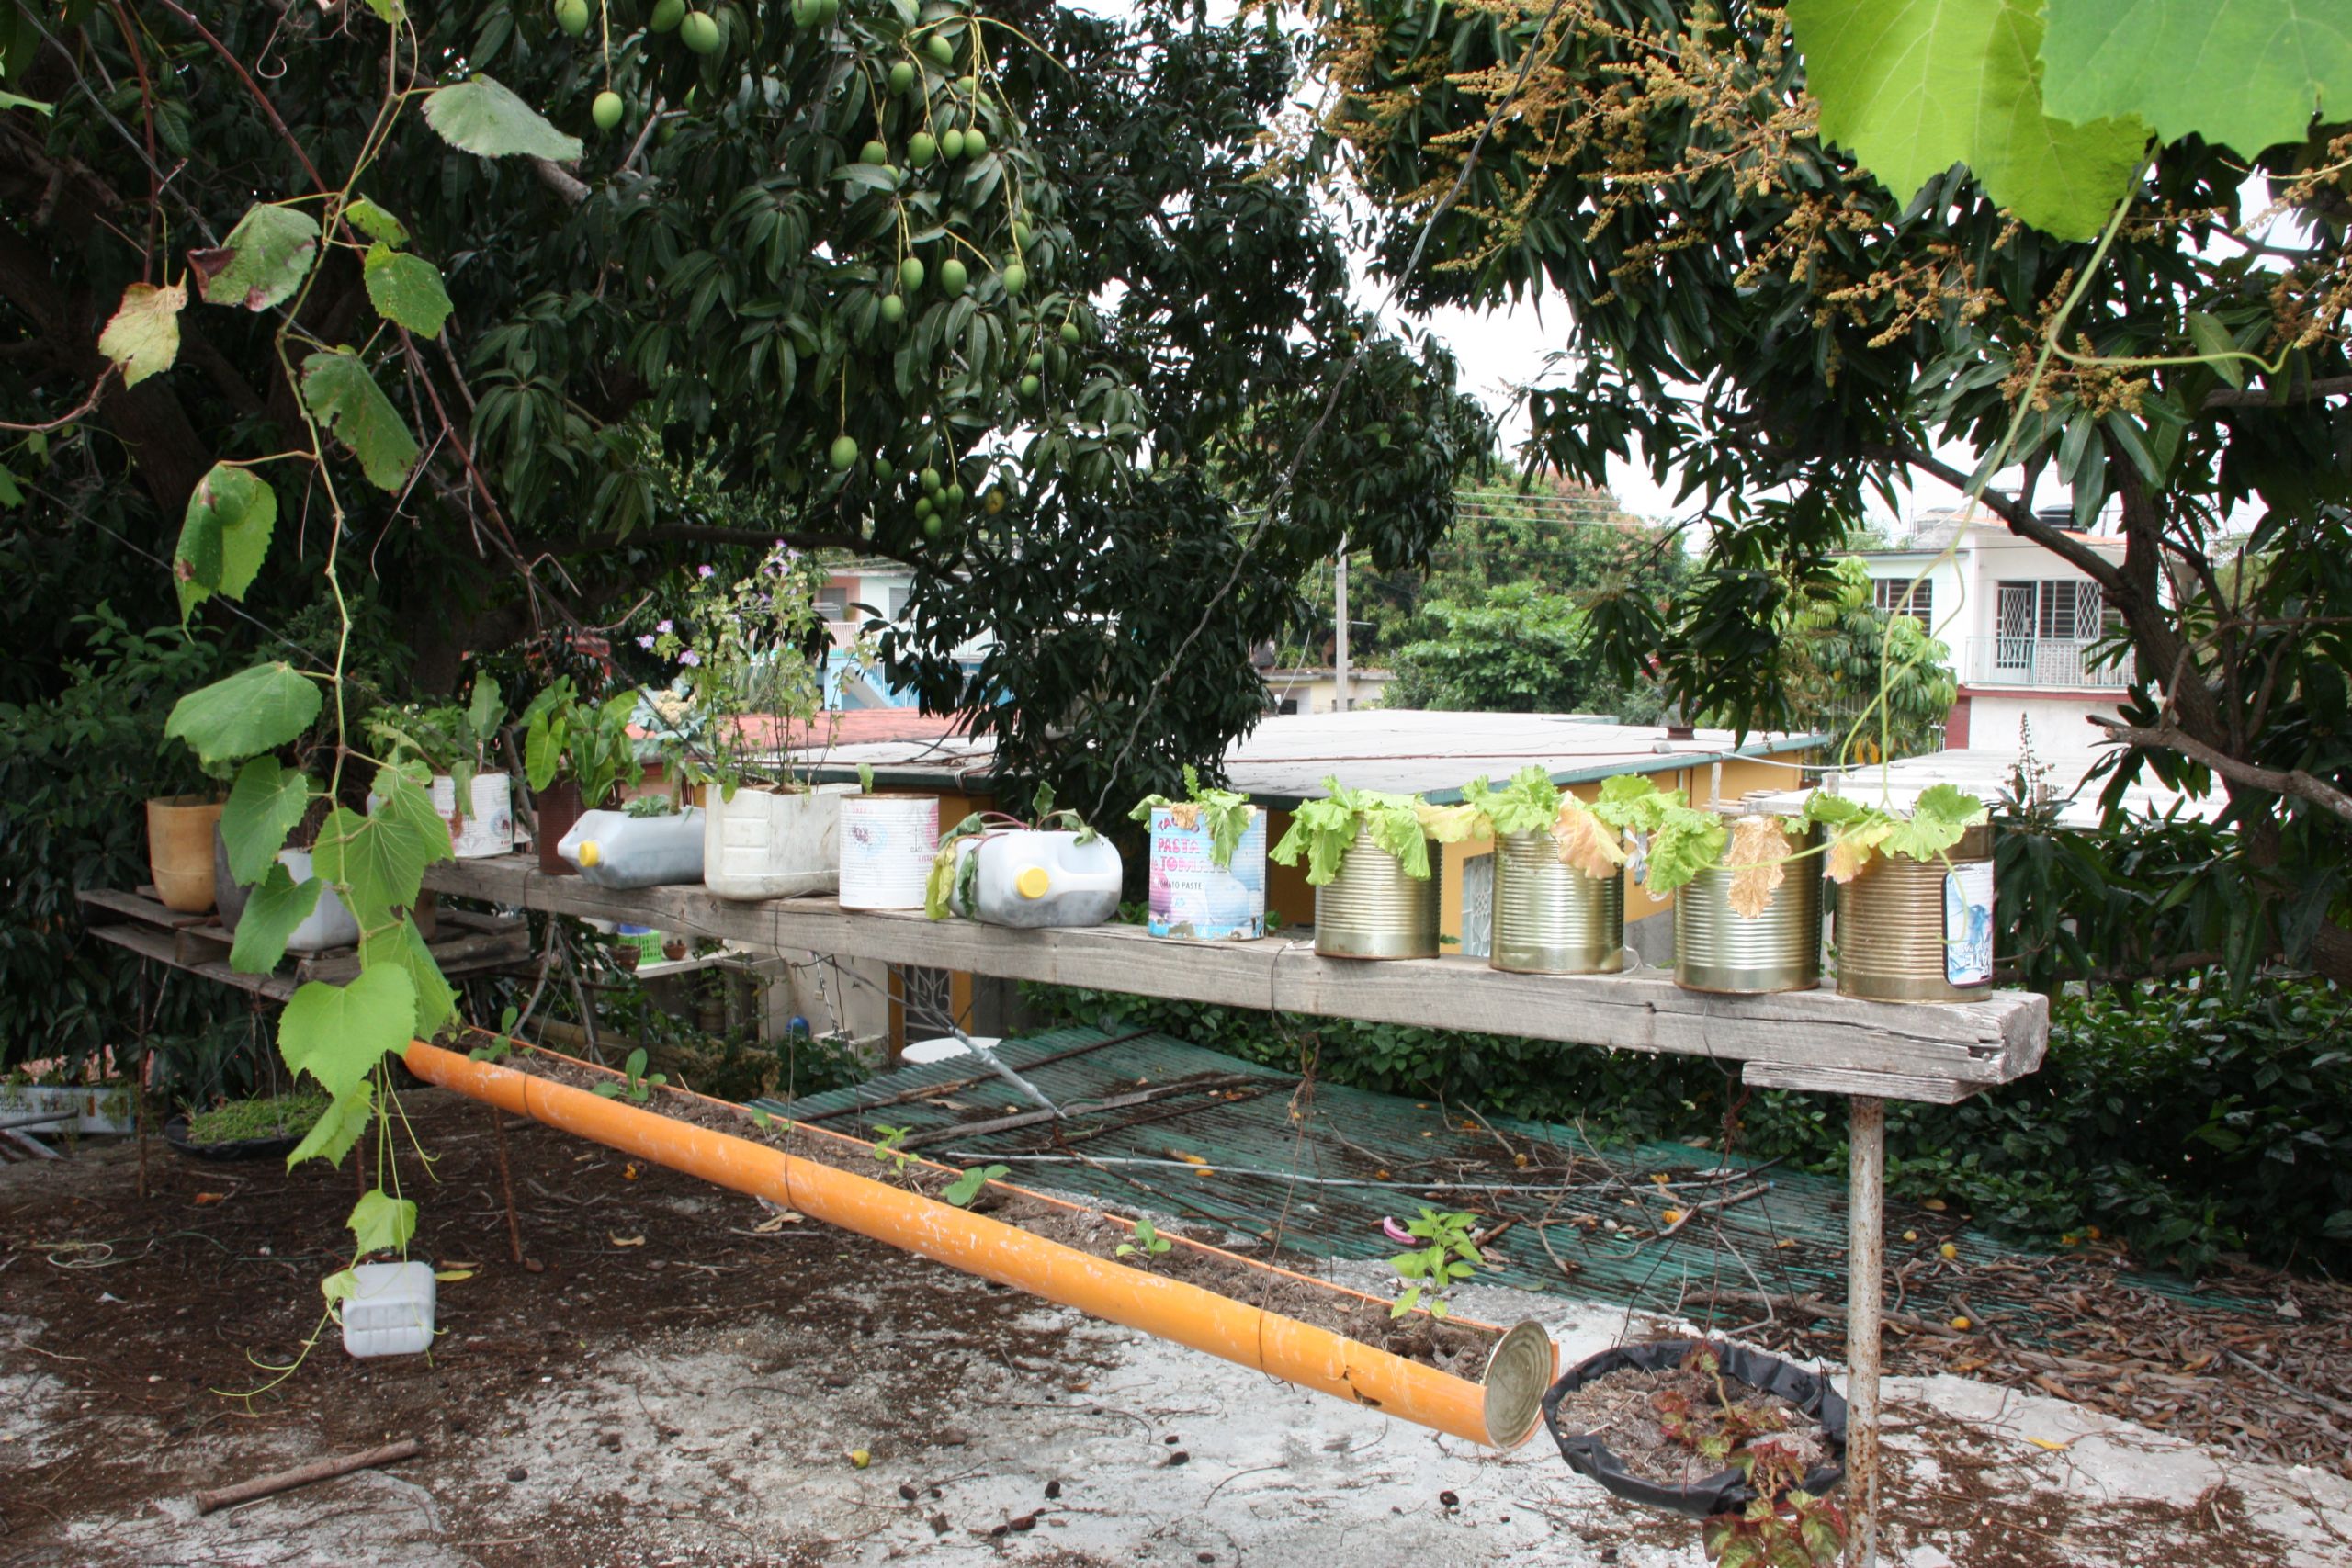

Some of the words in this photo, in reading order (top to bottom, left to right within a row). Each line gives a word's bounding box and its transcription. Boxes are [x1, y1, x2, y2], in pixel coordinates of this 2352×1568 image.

[1158, 837, 1200, 853] PASTA
[1158, 881, 1180, 889] TOMATO
[1182, 881, 1202, 889] PASTE
